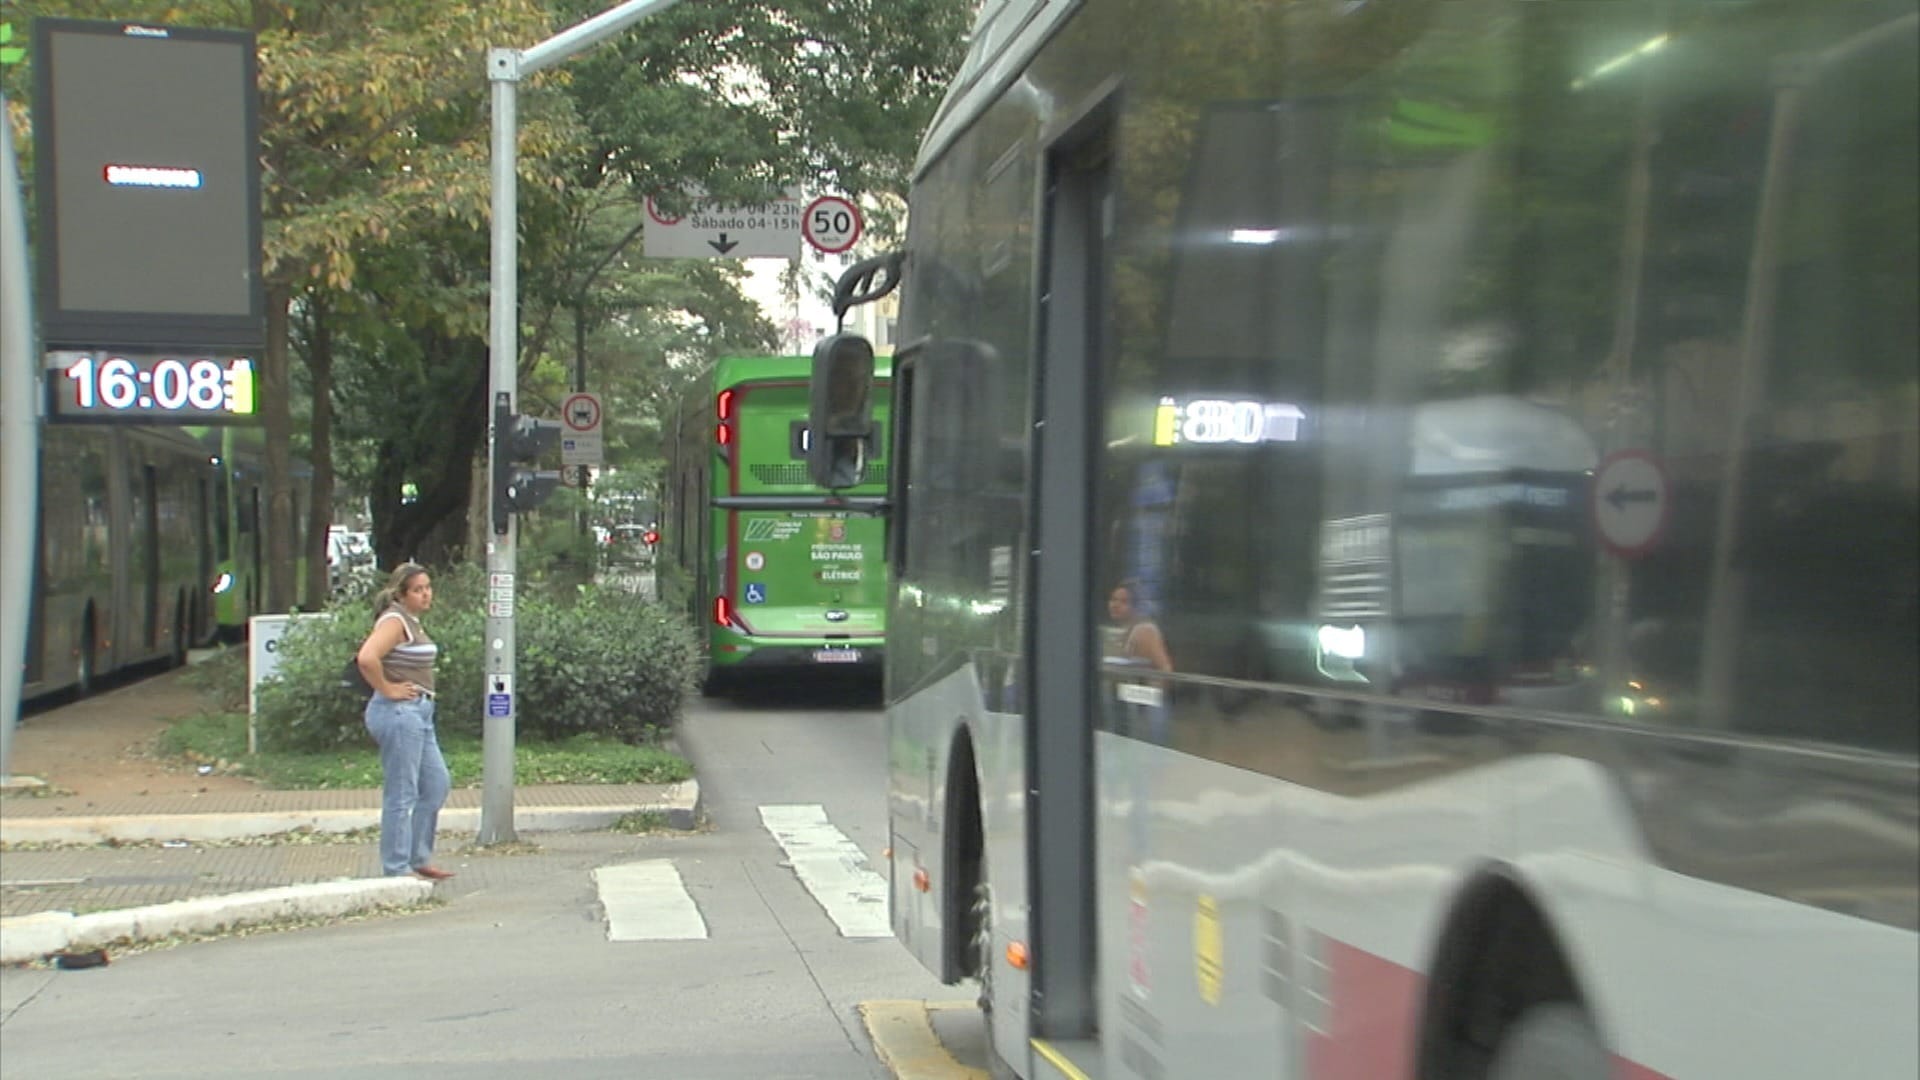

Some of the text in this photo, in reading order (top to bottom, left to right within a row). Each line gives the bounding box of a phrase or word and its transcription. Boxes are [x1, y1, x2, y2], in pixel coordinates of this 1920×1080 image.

[692, 217, 800, 229] Sábado 04-15h
[815, 210, 850, 233] 50
[66, 358, 224, 409] 16:08
[811, 551, 863, 560] SÃO PAULO
[822, 569, 860, 579] ELÉTRICO
